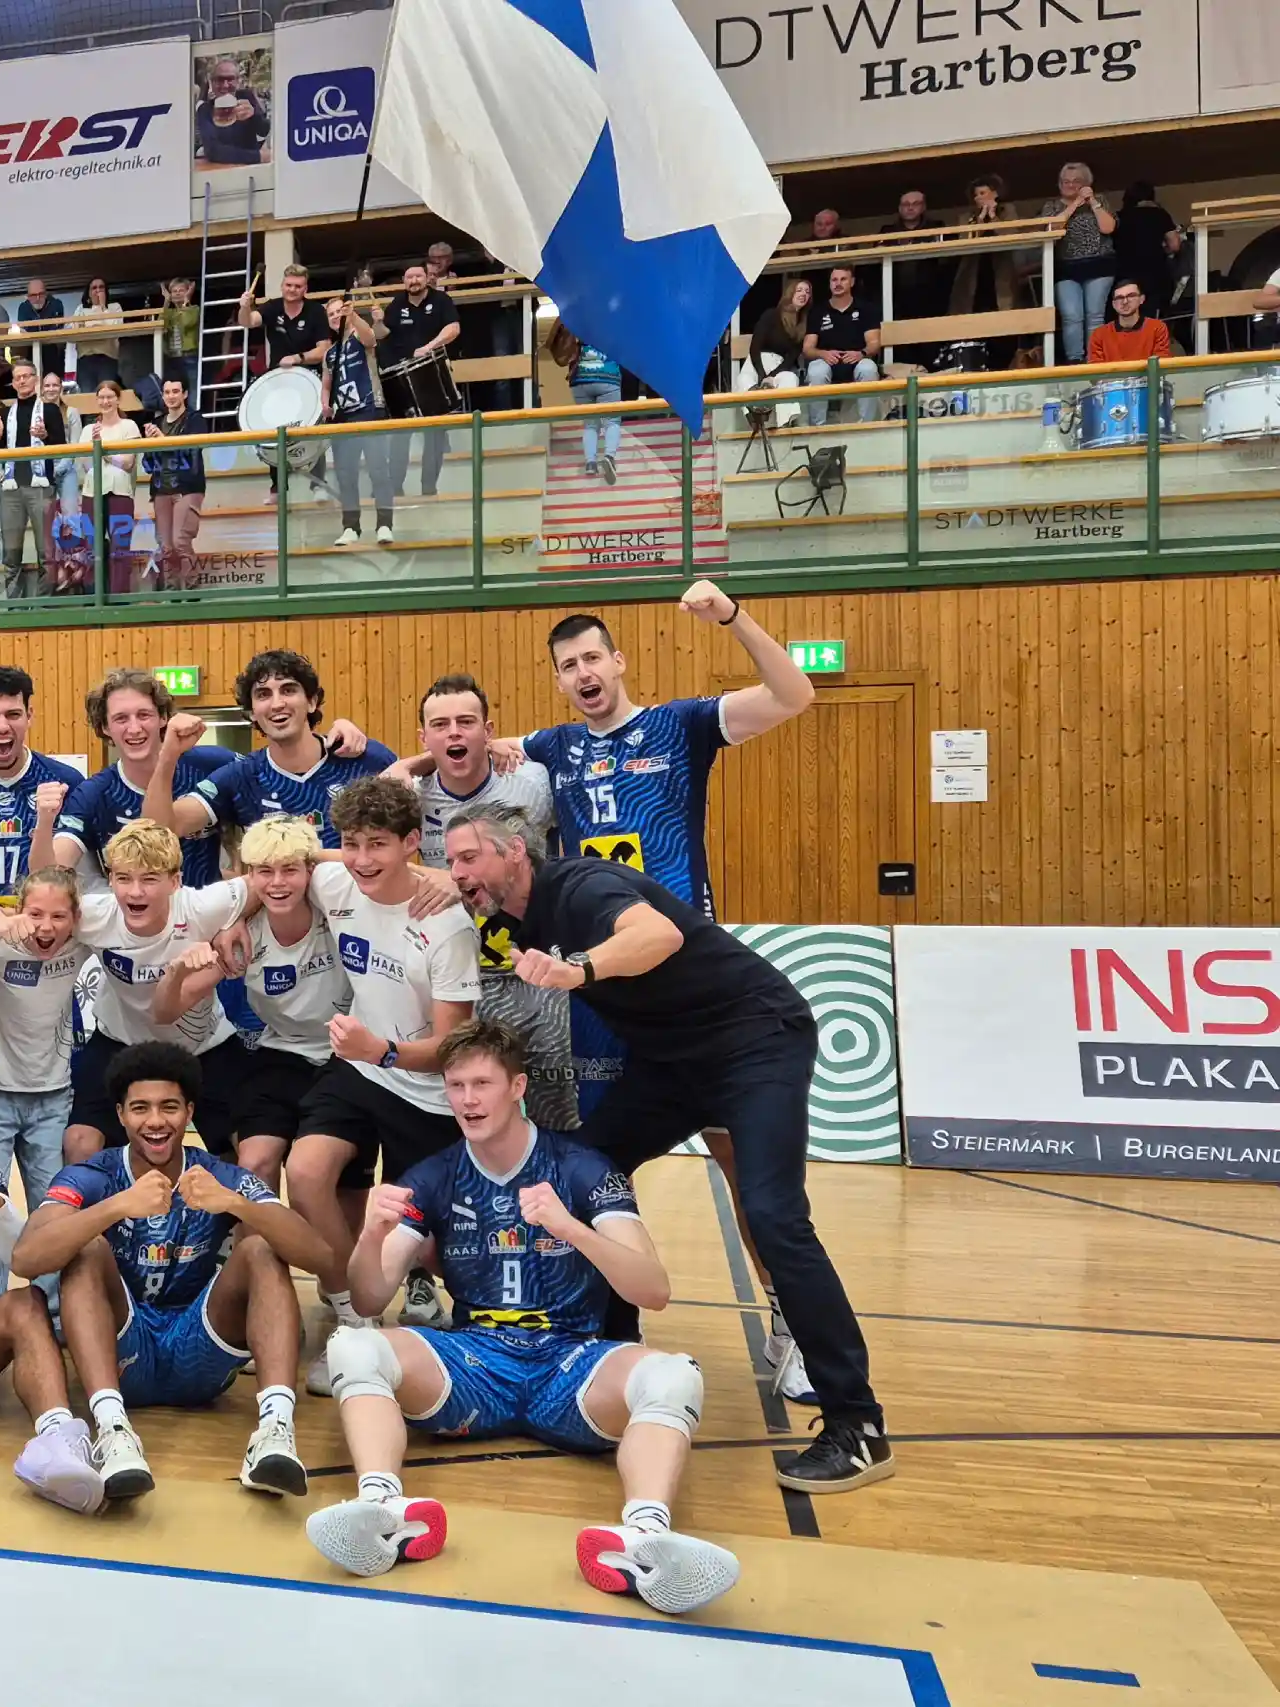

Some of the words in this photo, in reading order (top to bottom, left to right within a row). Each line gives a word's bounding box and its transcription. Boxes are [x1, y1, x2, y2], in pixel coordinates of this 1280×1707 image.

[860, 39, 1143, 101] Hartberg
[294, 123, 369, 146] UNIQA
[8, 155, 162, 184] elektro-regeltechnik.at
[935, 502, 1125, 530] STADTWERKE
[501, 530, 666, 555] STADTWERKE
[1034, 524, 1124, 539] Hartberg
[588, 551, 665, 564] Hartberg
[197, 572, 266, 584] Hartberg
[585, 784, 617, 824] 15
[6, 971, 36, 981] UNIQA
[45, 956, 76, 975] HAAS
[137, 968, 166, 980] HAA
[301, 954, 334, 975] HAAS
[371, 955, 404, 978] HAAS
[1070, 948, 1280, 1035] INS
[1094, 1055, 1280, 1090] PLAKA
[931, 1129, 1075, 1155] STEIERMARK
[453, 1222, 478, 1231] nine
[444, 1246, 479, 1255] HAAS
[502, 1260, 521, 1304] 9
